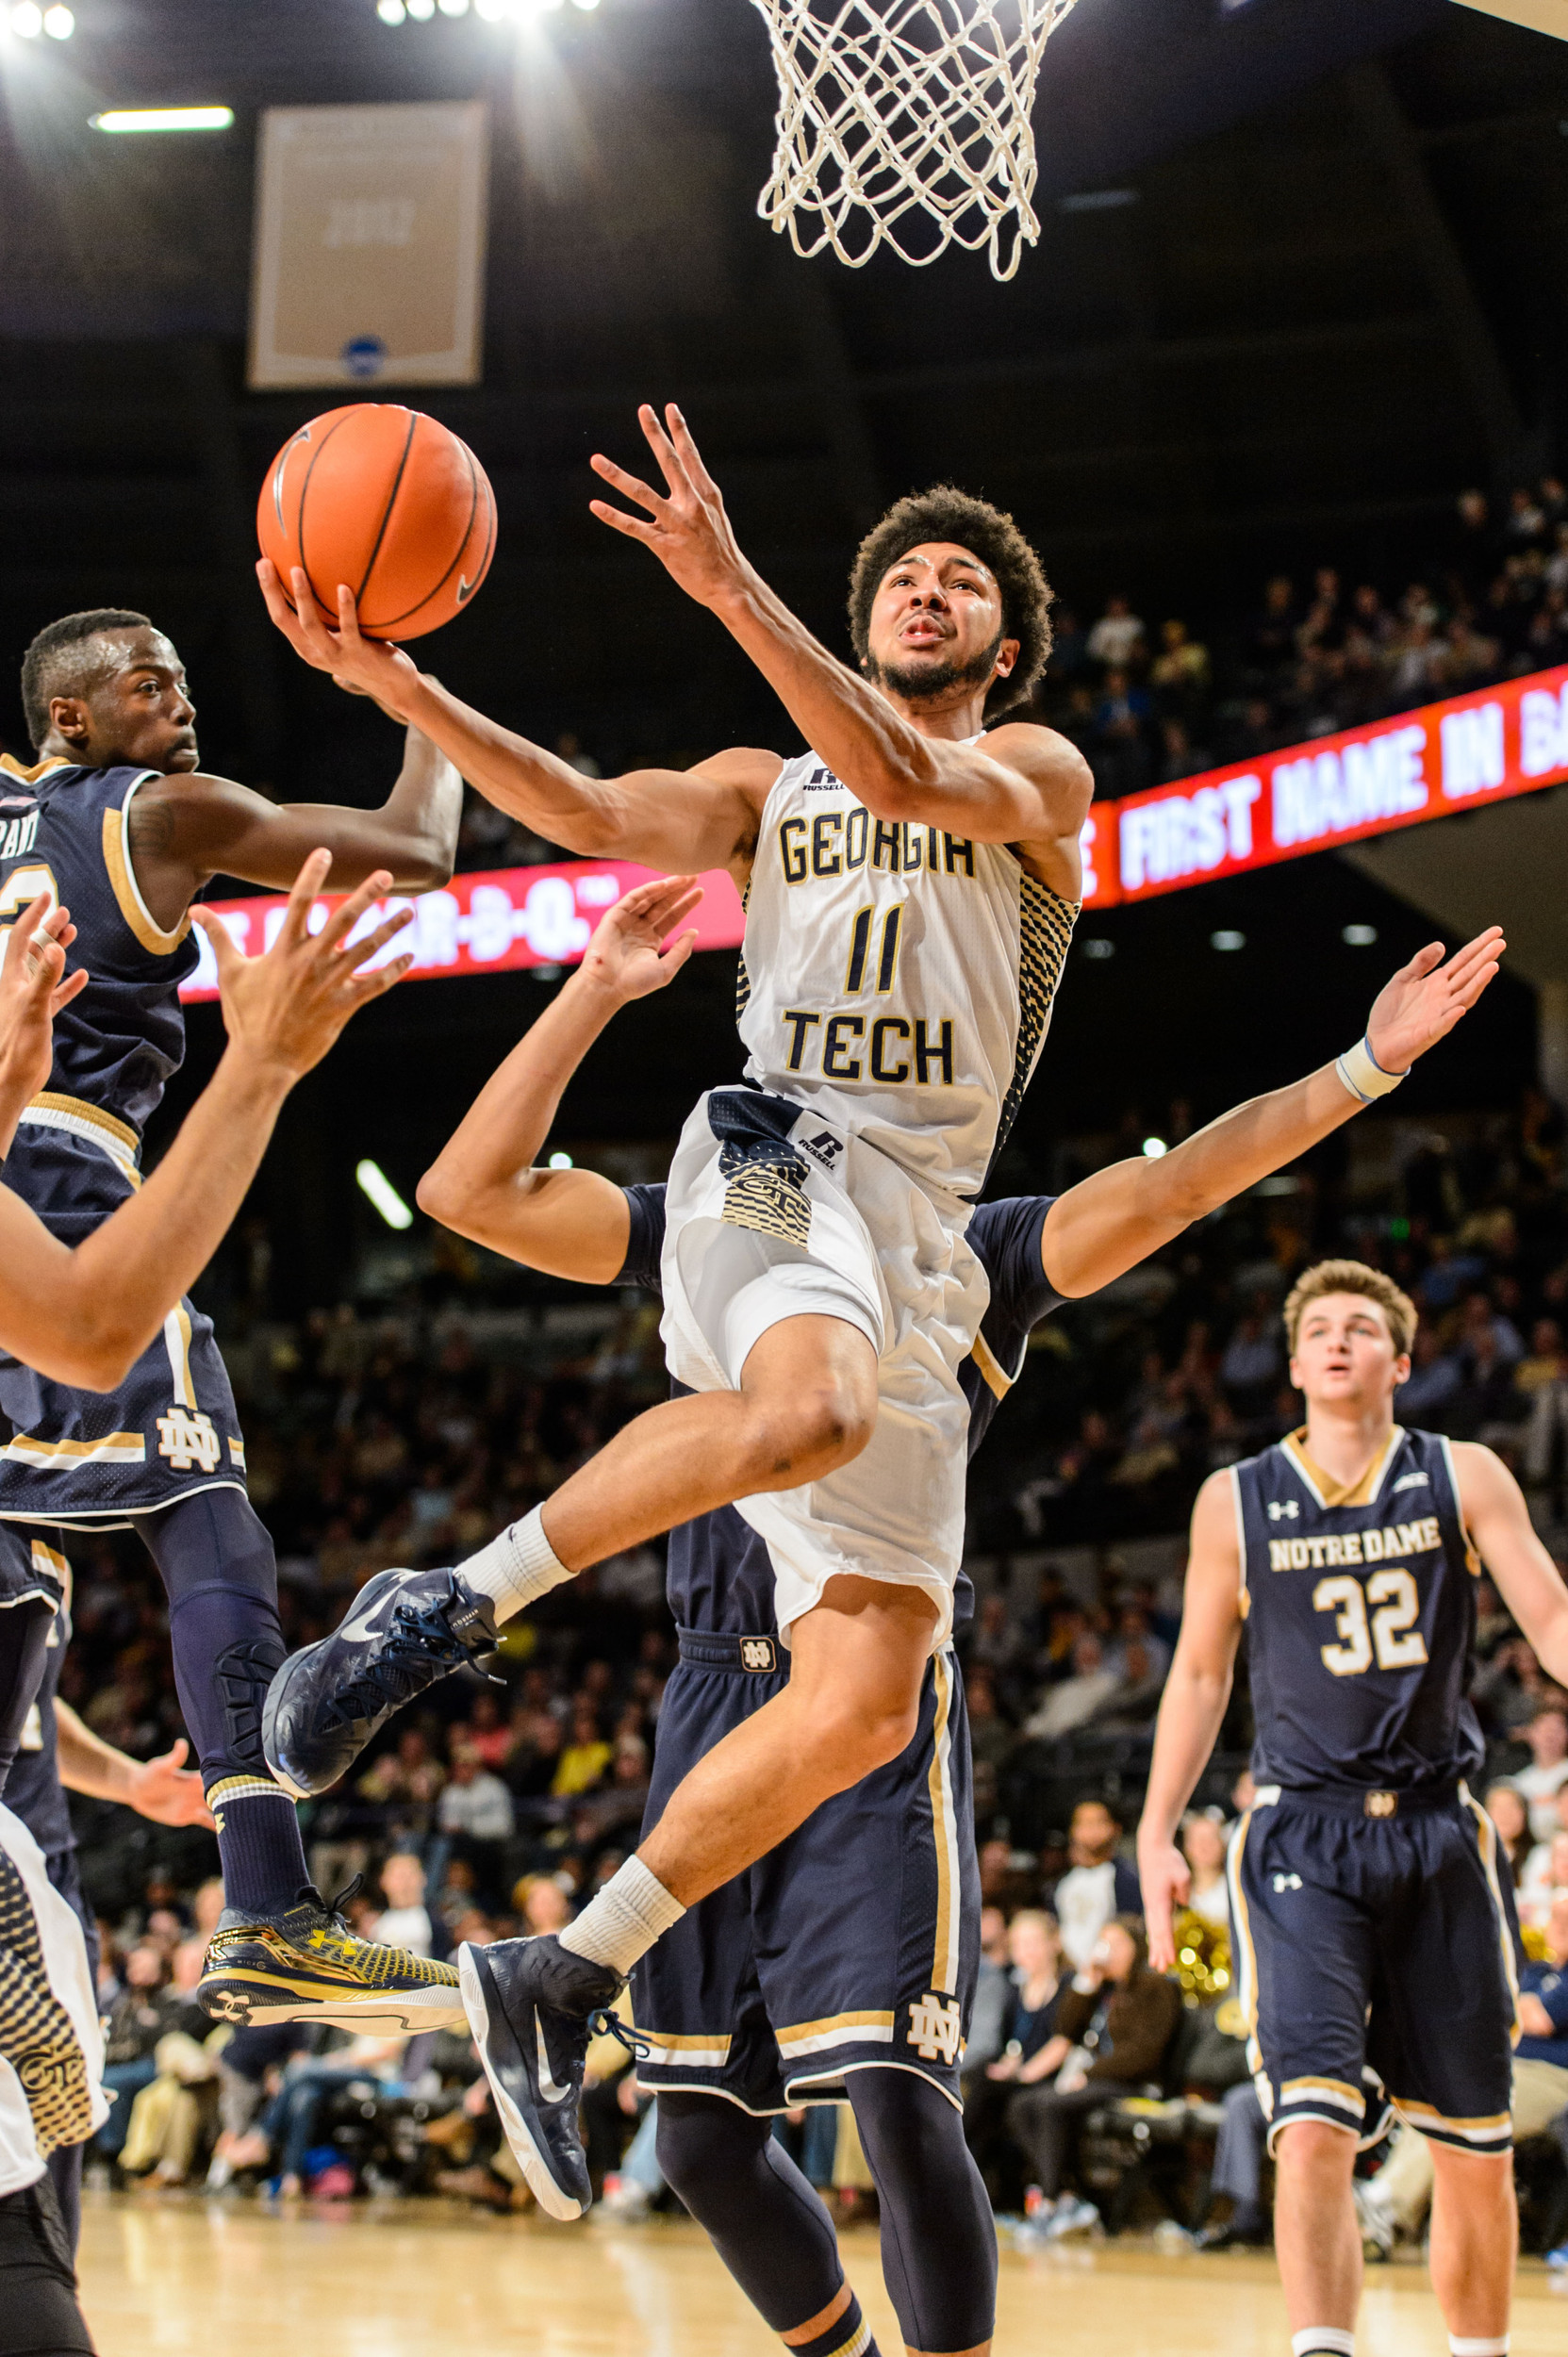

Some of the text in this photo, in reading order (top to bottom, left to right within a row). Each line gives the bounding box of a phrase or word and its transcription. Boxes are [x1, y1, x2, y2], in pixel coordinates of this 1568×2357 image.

[1119, 773, 1262, 890] FIRST
[1272, 724, 1428, 848] NAME
[1440, 701, 1505, 799] IN
[778, 805, 977, 887] GEORGIA
[843, 902, 905, 996] 11
[782, 1010, 954, 1085] TECH
[798, 1139, 836, 1171] RUSSELL
[1269, 1516, 1443, 1572] NOTRE DAME
[452, 1608, 479, 1630] HYPERQU
[1312, 1568, 1429, 1676] 32
